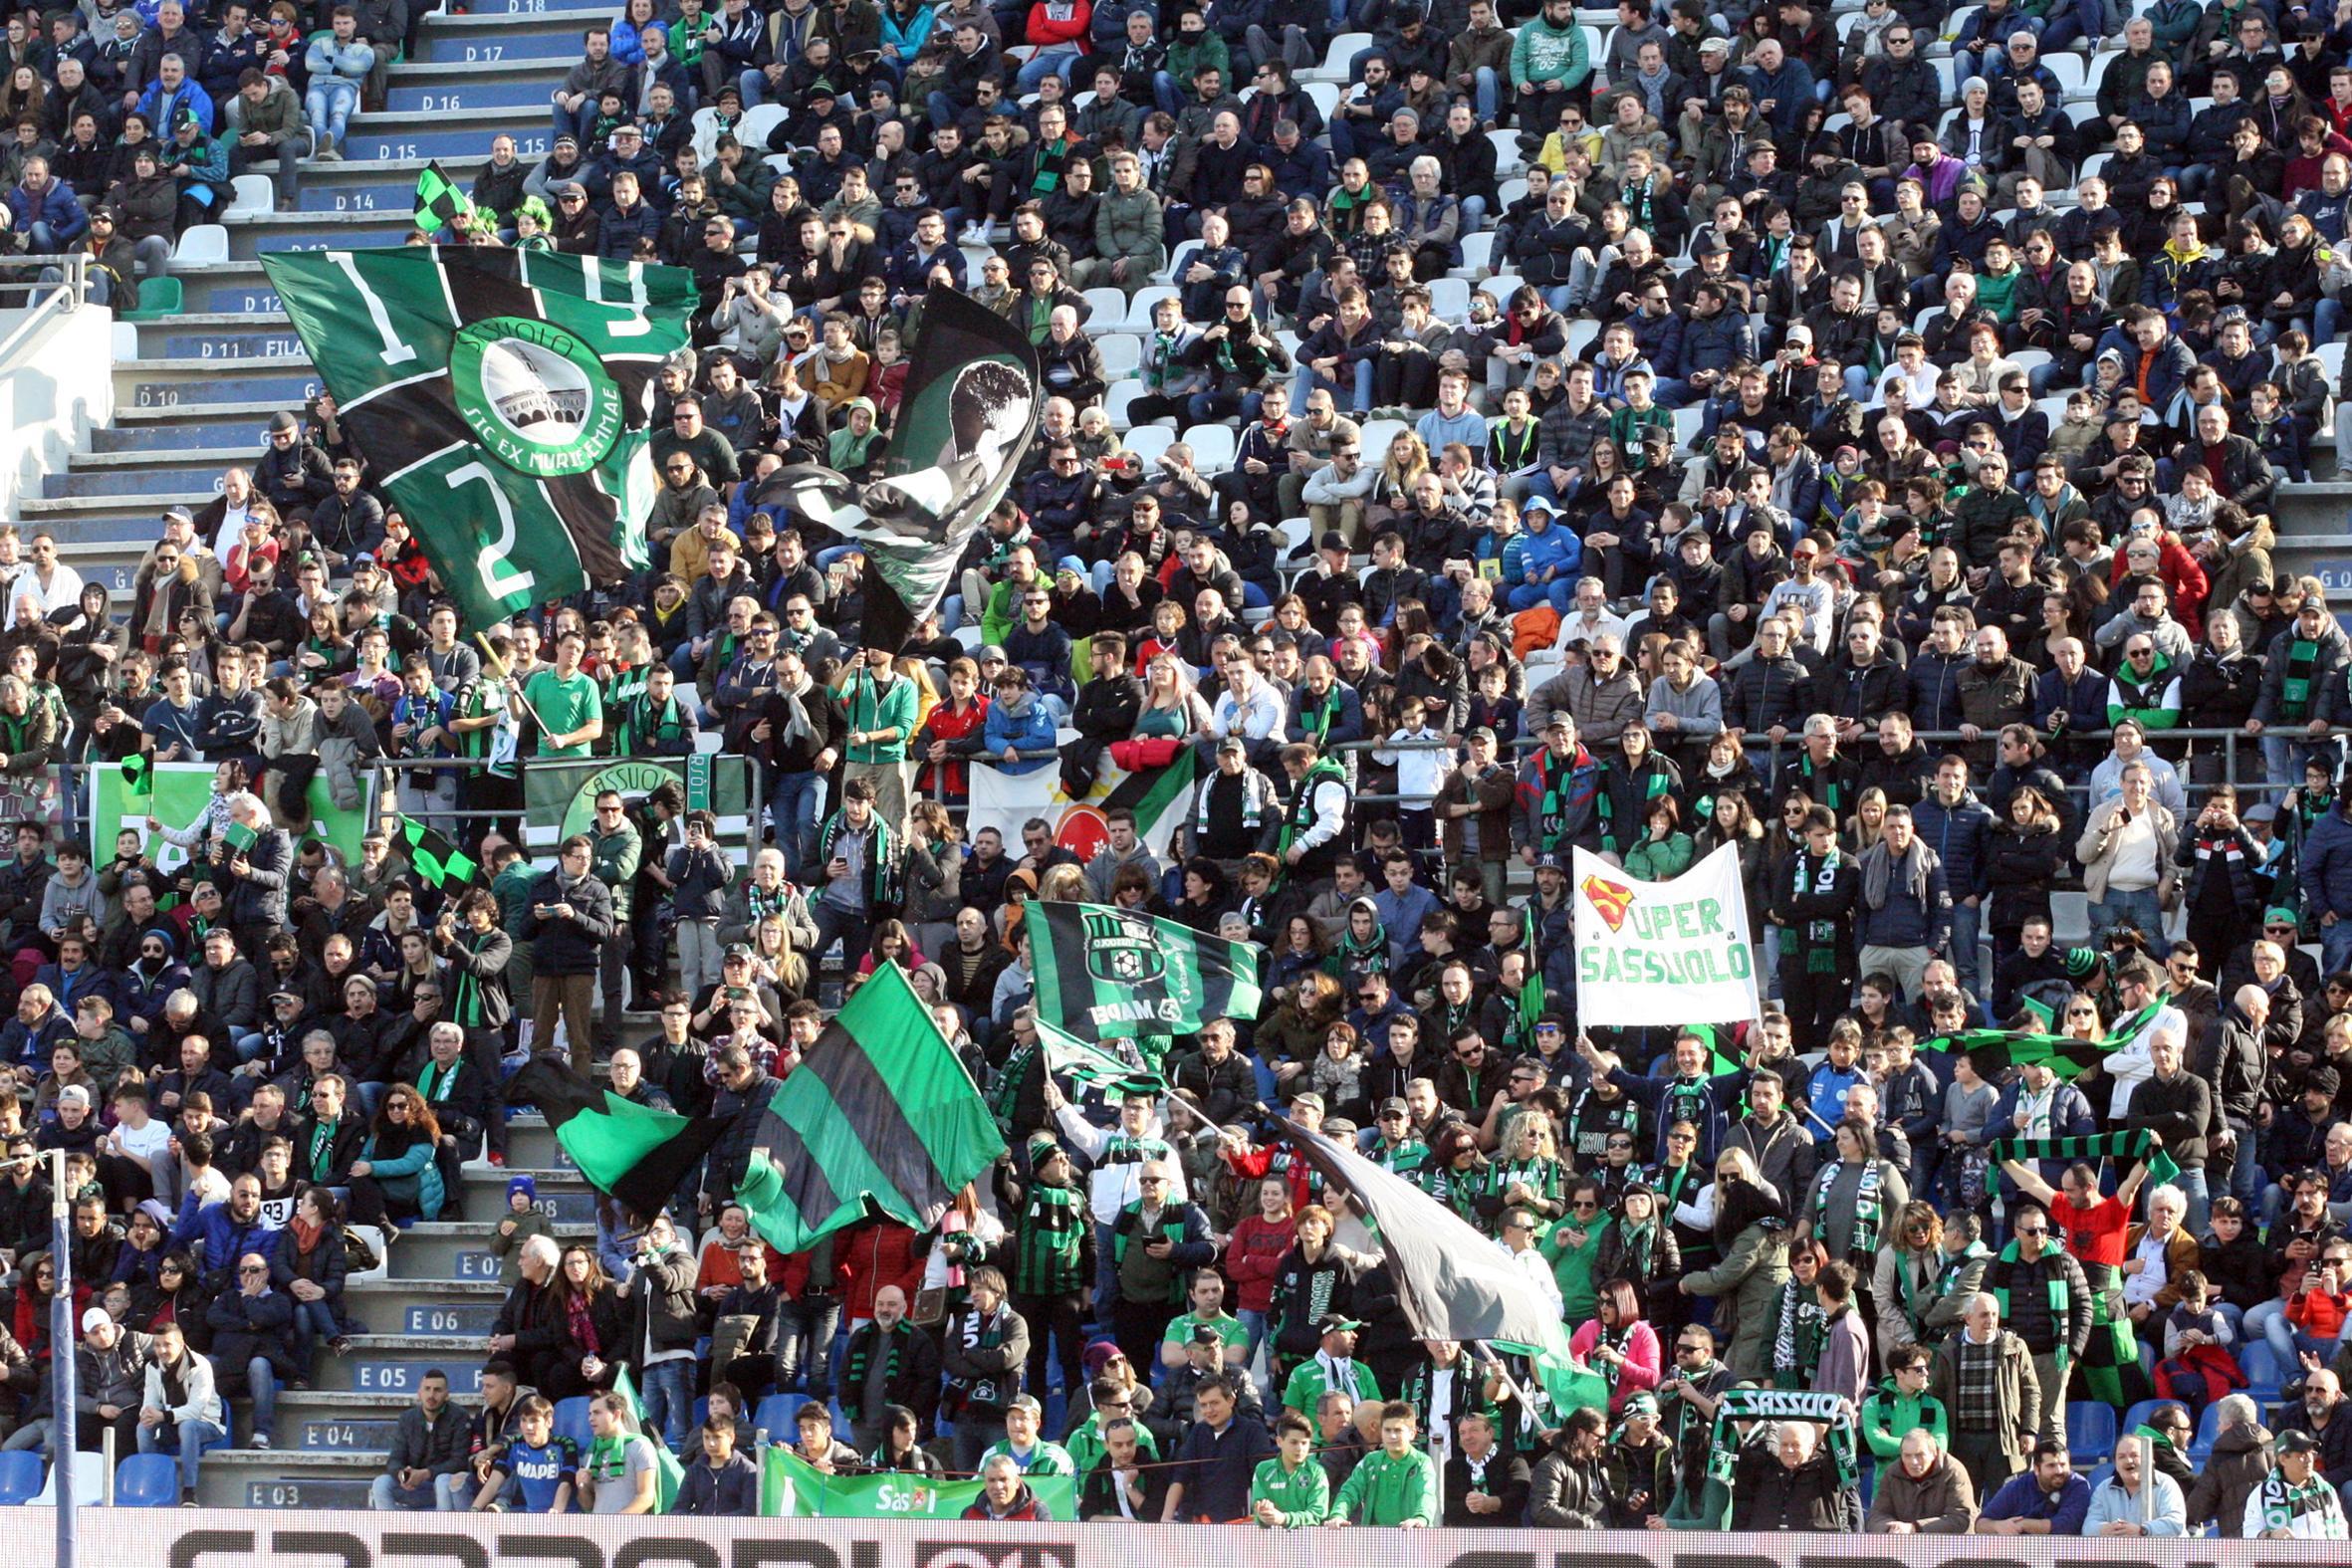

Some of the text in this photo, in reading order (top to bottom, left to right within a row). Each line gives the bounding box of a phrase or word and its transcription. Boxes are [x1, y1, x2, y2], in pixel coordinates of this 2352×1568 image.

[508, 0, 546, 13] D 18
[466, 46, 503, 61] D 17
[422, 95, 460, 111] D 16
[379, 143, 416, 159] D 15
[336, 194, 373, 210] D 14
[245, 296, 282, 312] D 12
[201, 340, 306, 357] D 11 FILA
[140, 383, 316, 406] D 10 G
[463, 407, 496, 441] SIC
[498, 438, 524, 465] EX
[116, 573, 125, 588] G
[2319, 570, 2332, 585] G
[1580, 942, 1752, 985] SASSUOLO
[263, 1203, 284, 1221] 93
[462, 1258, 471, 1274] E
[412, 1311, 458, 1331] E 06
[360, 1369, 369, 1385] E
[379, 1368, 406, 1386] 05
[308, 1426, 353, 1444] E 04
[253, 1486, 299, 1504] E 03
